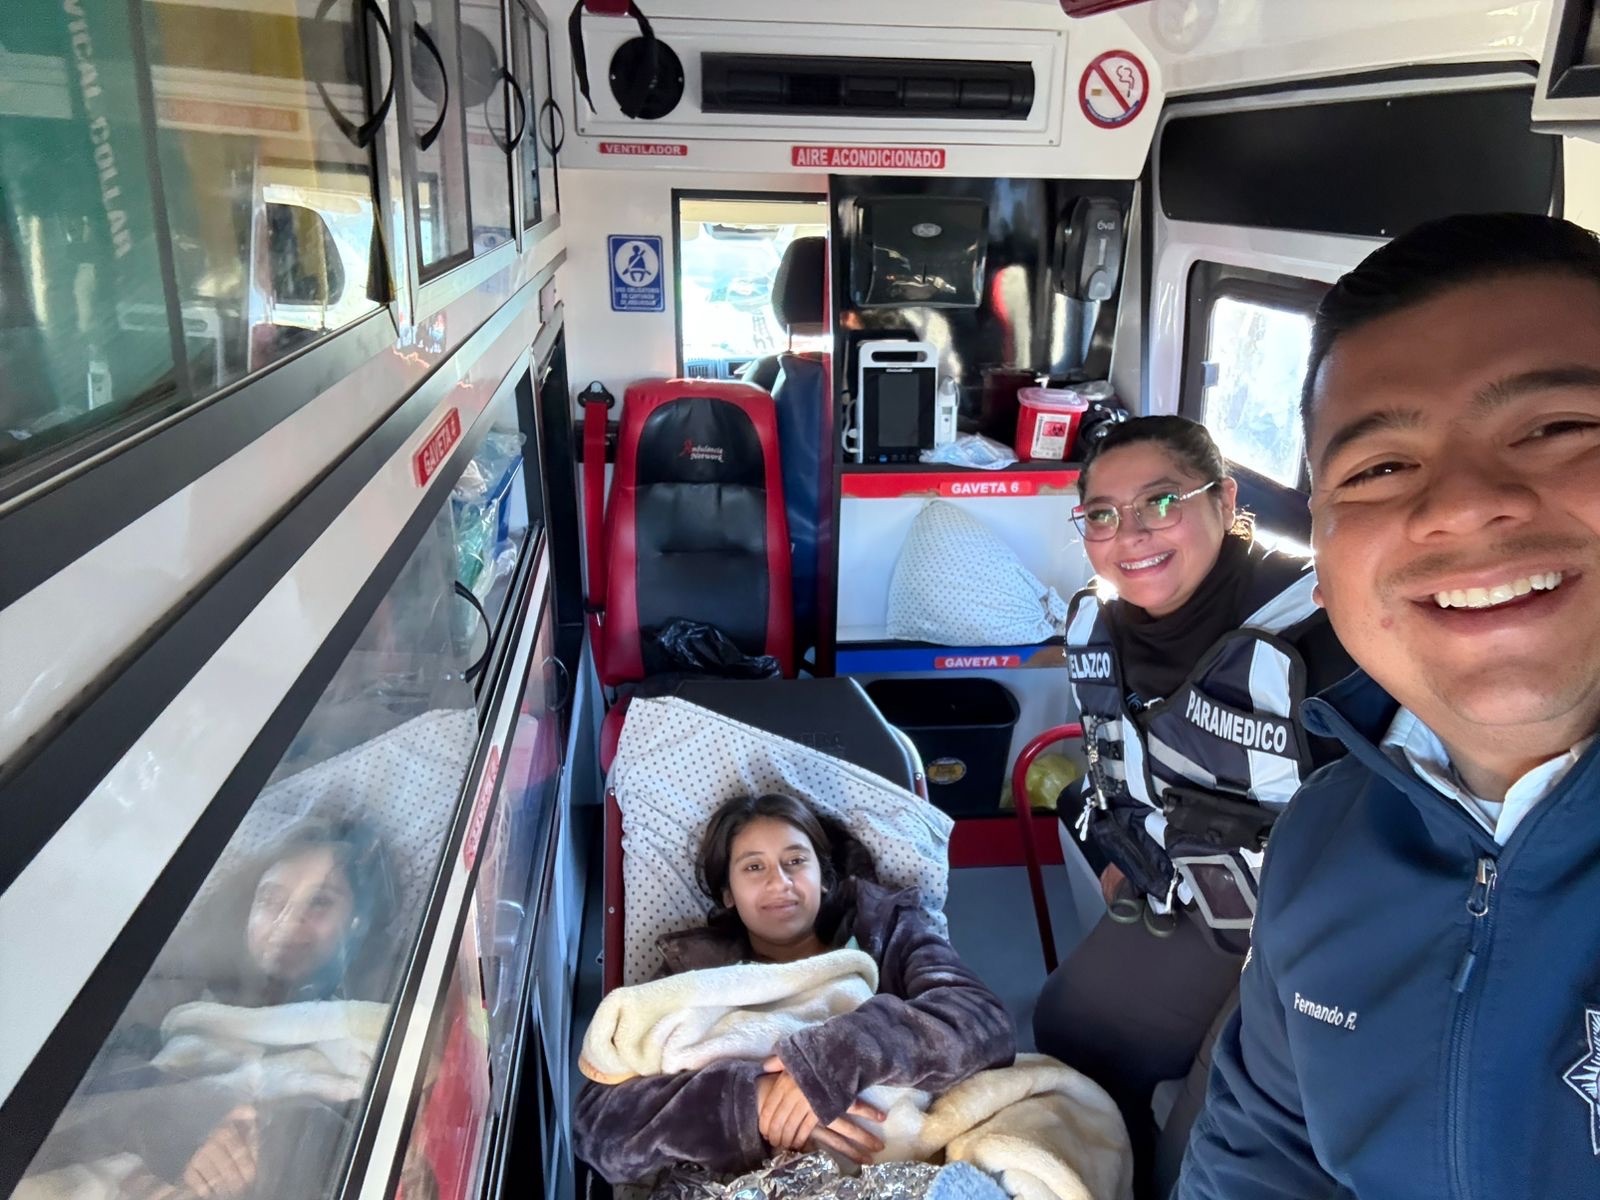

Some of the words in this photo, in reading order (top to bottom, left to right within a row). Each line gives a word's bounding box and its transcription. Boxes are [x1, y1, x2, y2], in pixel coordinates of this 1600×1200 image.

[603, 145, 682, 155] VENTILADOR
[797, 148, 828, 165] AIRE
[832, 149, 941, 167] ACONDICIONADO
[423, 423, 452, 477] GAVETA
[951, 483, 1007, 494] GAVETA
[1011, 482, 1019, 493] 6
[945, 657, 998, 668] GAVETA
[1002, 656, 1009, 666] 7
[1185, 689, 1287, 753] PARAMEDICO
[1293, 991, 1344, 1026] Fernando
